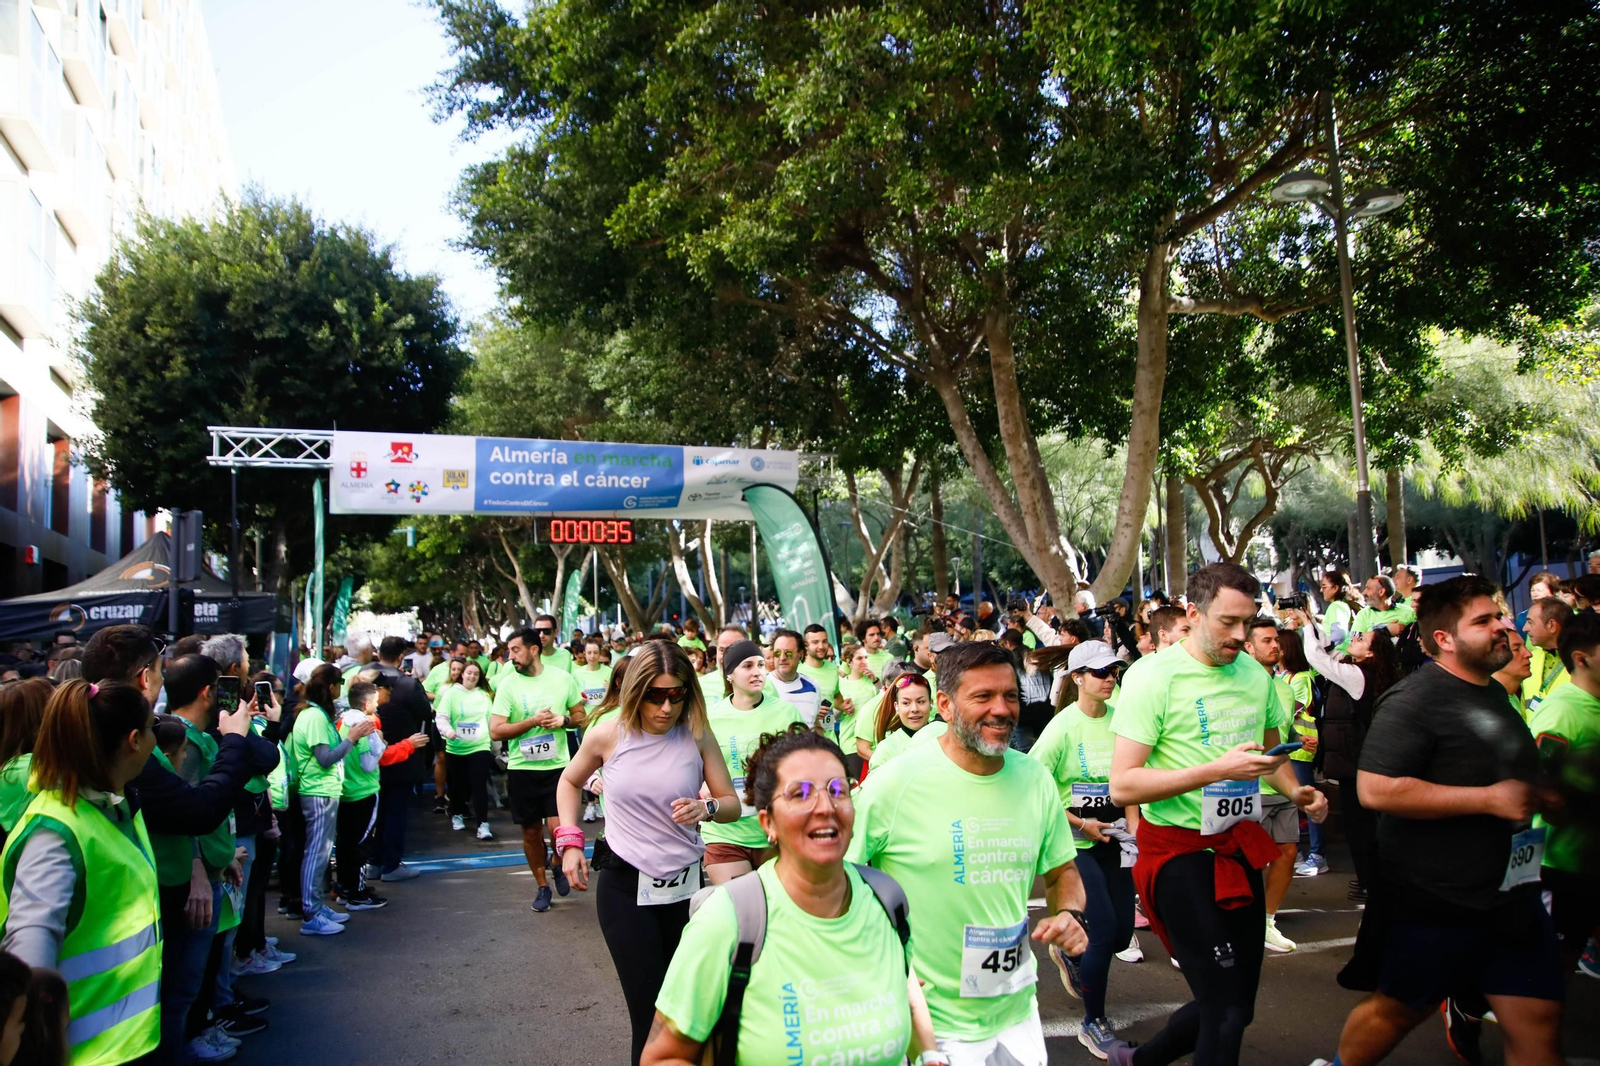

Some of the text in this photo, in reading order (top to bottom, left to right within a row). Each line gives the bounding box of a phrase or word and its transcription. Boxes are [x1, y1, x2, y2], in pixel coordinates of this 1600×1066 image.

[489, 446, 673, 469] Almería en marcha
[489, 469, 650, 489] contra el cáncer
[588, 692, 603, 700] 206
[1209, 704, 1257, 720] En marcha
[1194, 698, 1211, 747] ALMERÍA
[1211, 715, 1257, 731] contra el
[1213, 727, 1256, 747] cáncer
[528, 742, 550, 755] 179
[729, 735, 739, 770] ALMERÍA
[1078, 742, 1089, 778] ALMERÍA
[1216, 796, 1254, 818] 805
[949, 819, 966, 885] ALMERÍA
[967, 836, 1033, 850] En marcha
[969, 849, 1033, 865] contra el
[969, 865, 1030, 885] cáncer
[968, 928, 995, 936] Almería
[968, 935, 991, 943] contra
[991, 935, 999, 943] el
[804, 991, 896, 1025] En marcha
[808, 1006, 903, 1046] contra el
